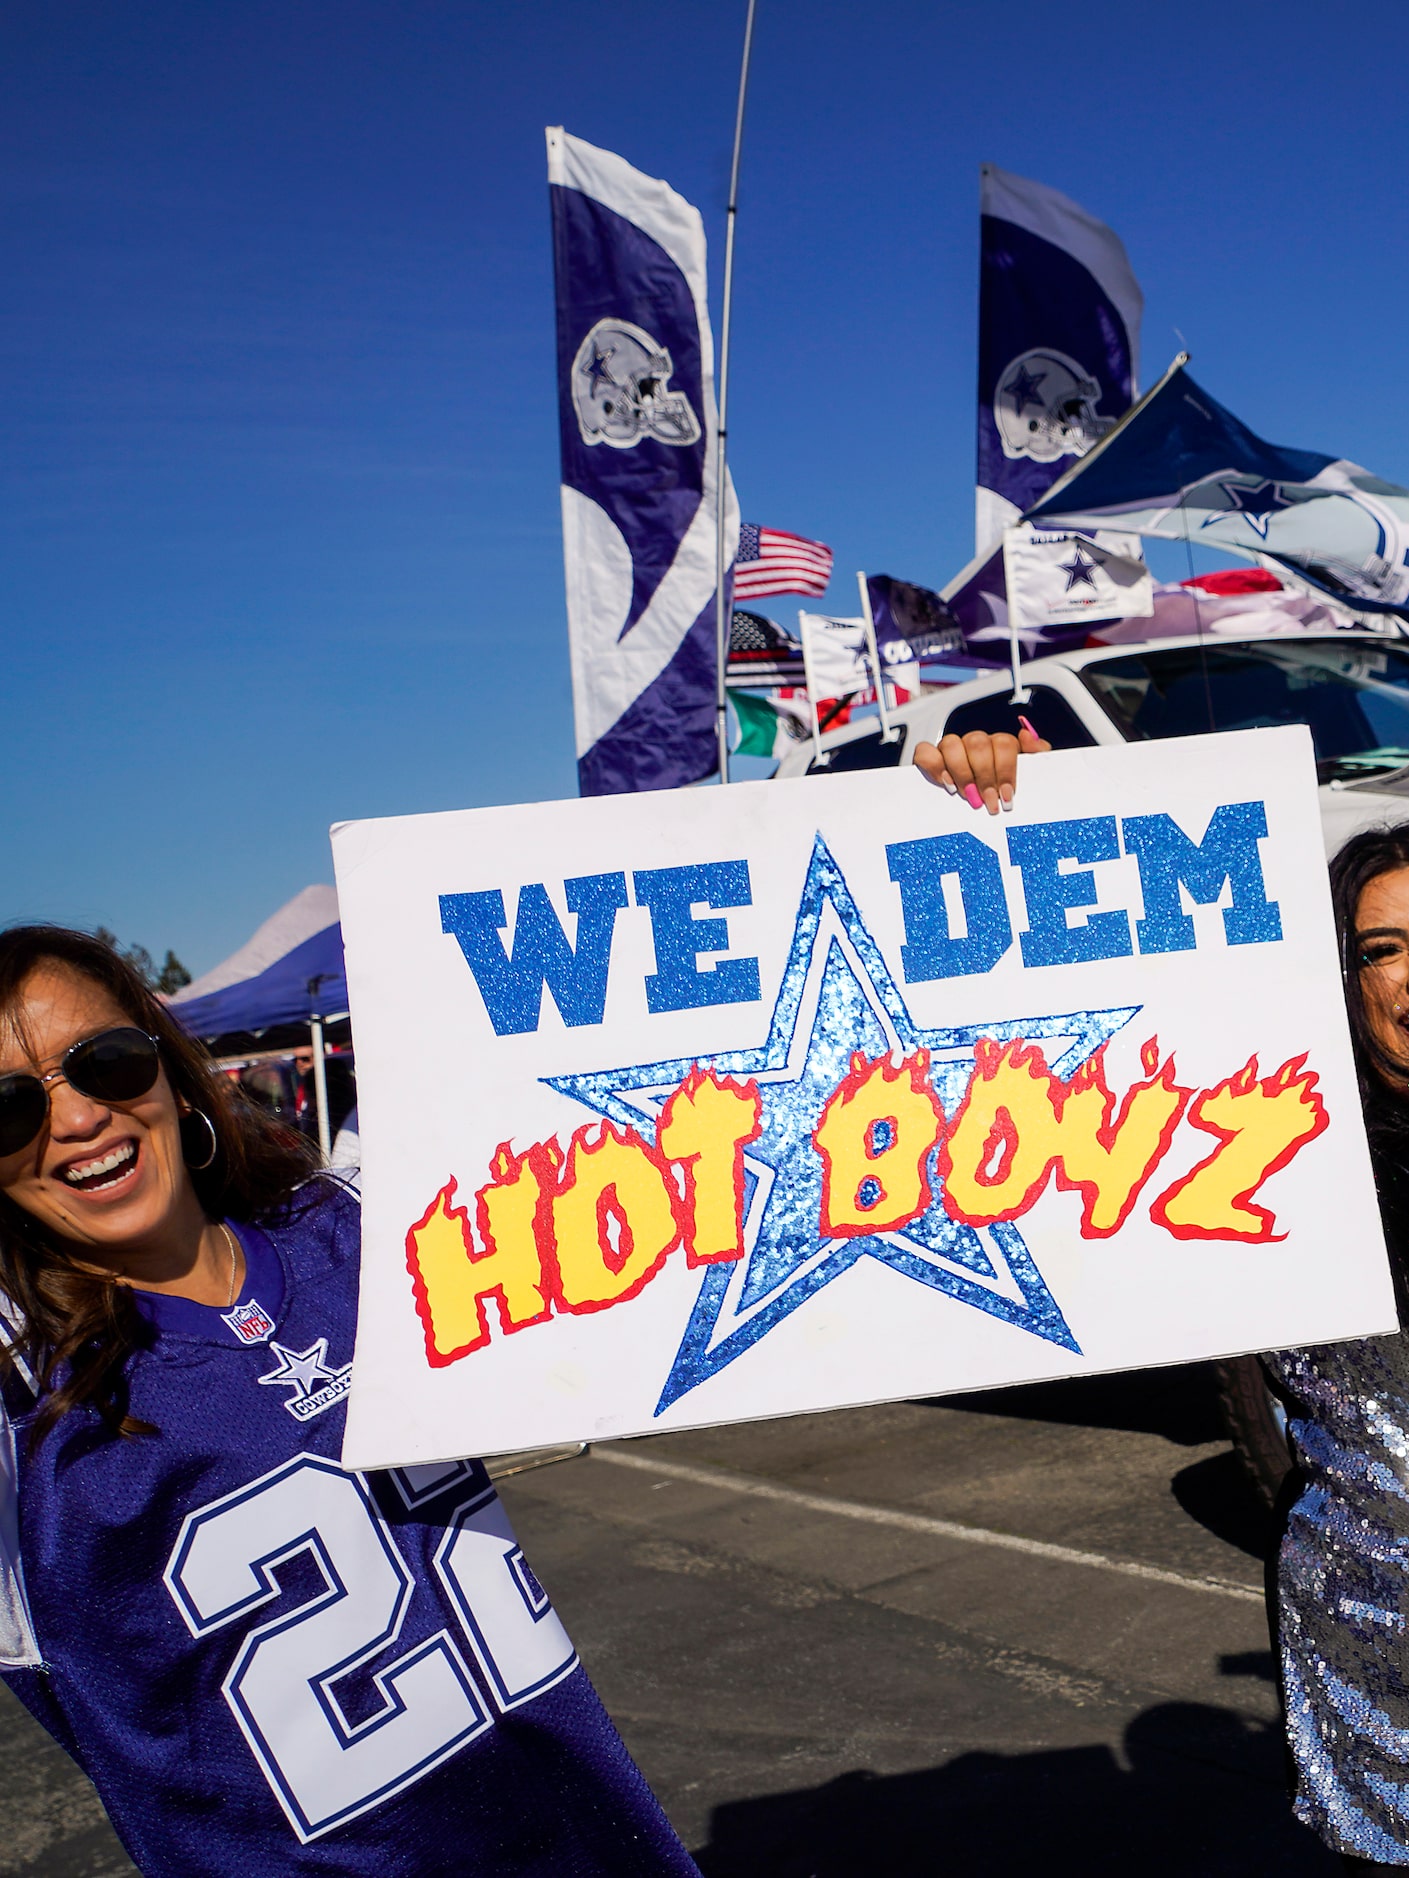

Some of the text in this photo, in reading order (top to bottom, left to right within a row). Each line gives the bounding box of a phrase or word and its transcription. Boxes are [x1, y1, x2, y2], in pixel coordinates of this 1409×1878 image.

[438, 801, 1284, 1037] WE DEM
[405, 1036, 1331, 1370] HOT BOYZ
[237, 1315, 270, 1340] NFL
